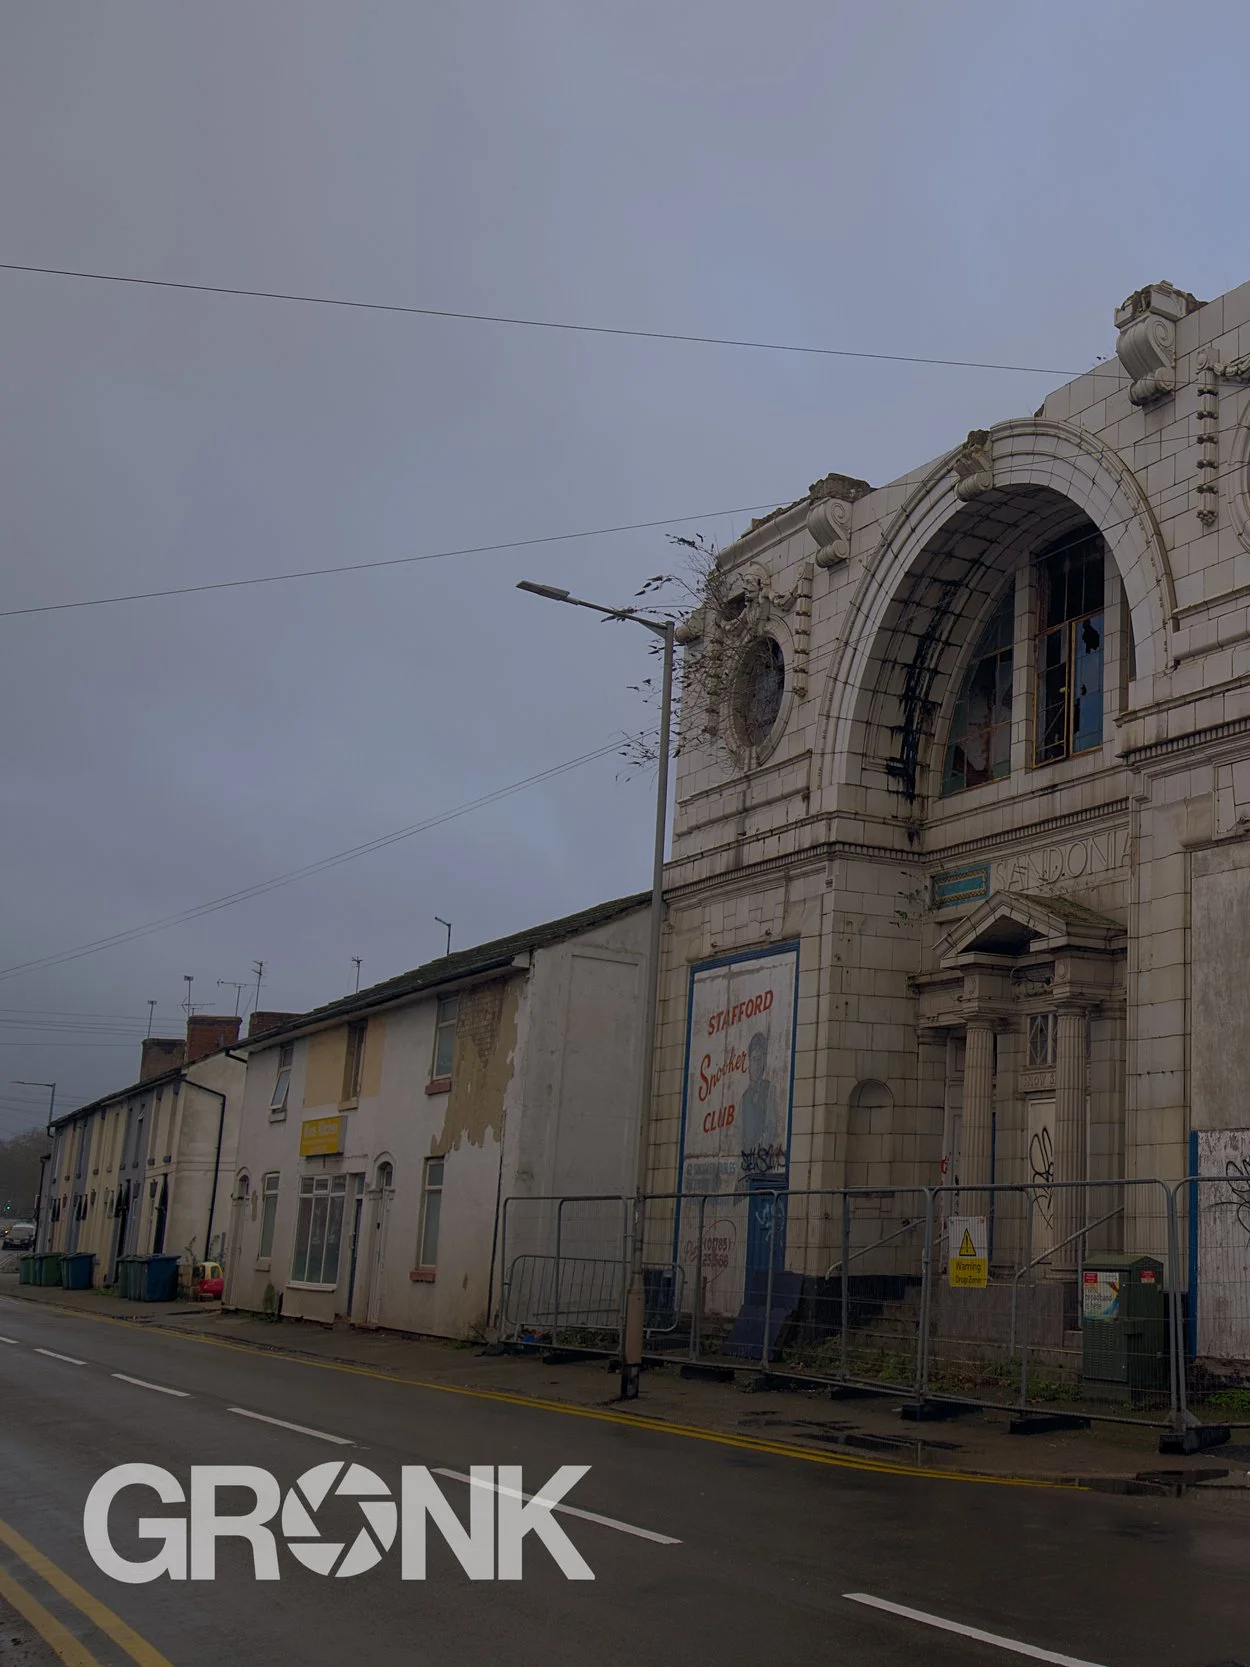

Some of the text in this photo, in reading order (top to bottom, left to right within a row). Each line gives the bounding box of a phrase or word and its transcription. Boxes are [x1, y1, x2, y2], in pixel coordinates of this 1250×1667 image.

[708, 990, 774, 1036] STAFFORD
[698, 1046, 748, 1102] Snooker
[703, 1104, 735, 1134] CLUB
[956, 1262, 981, 1273] Warning
